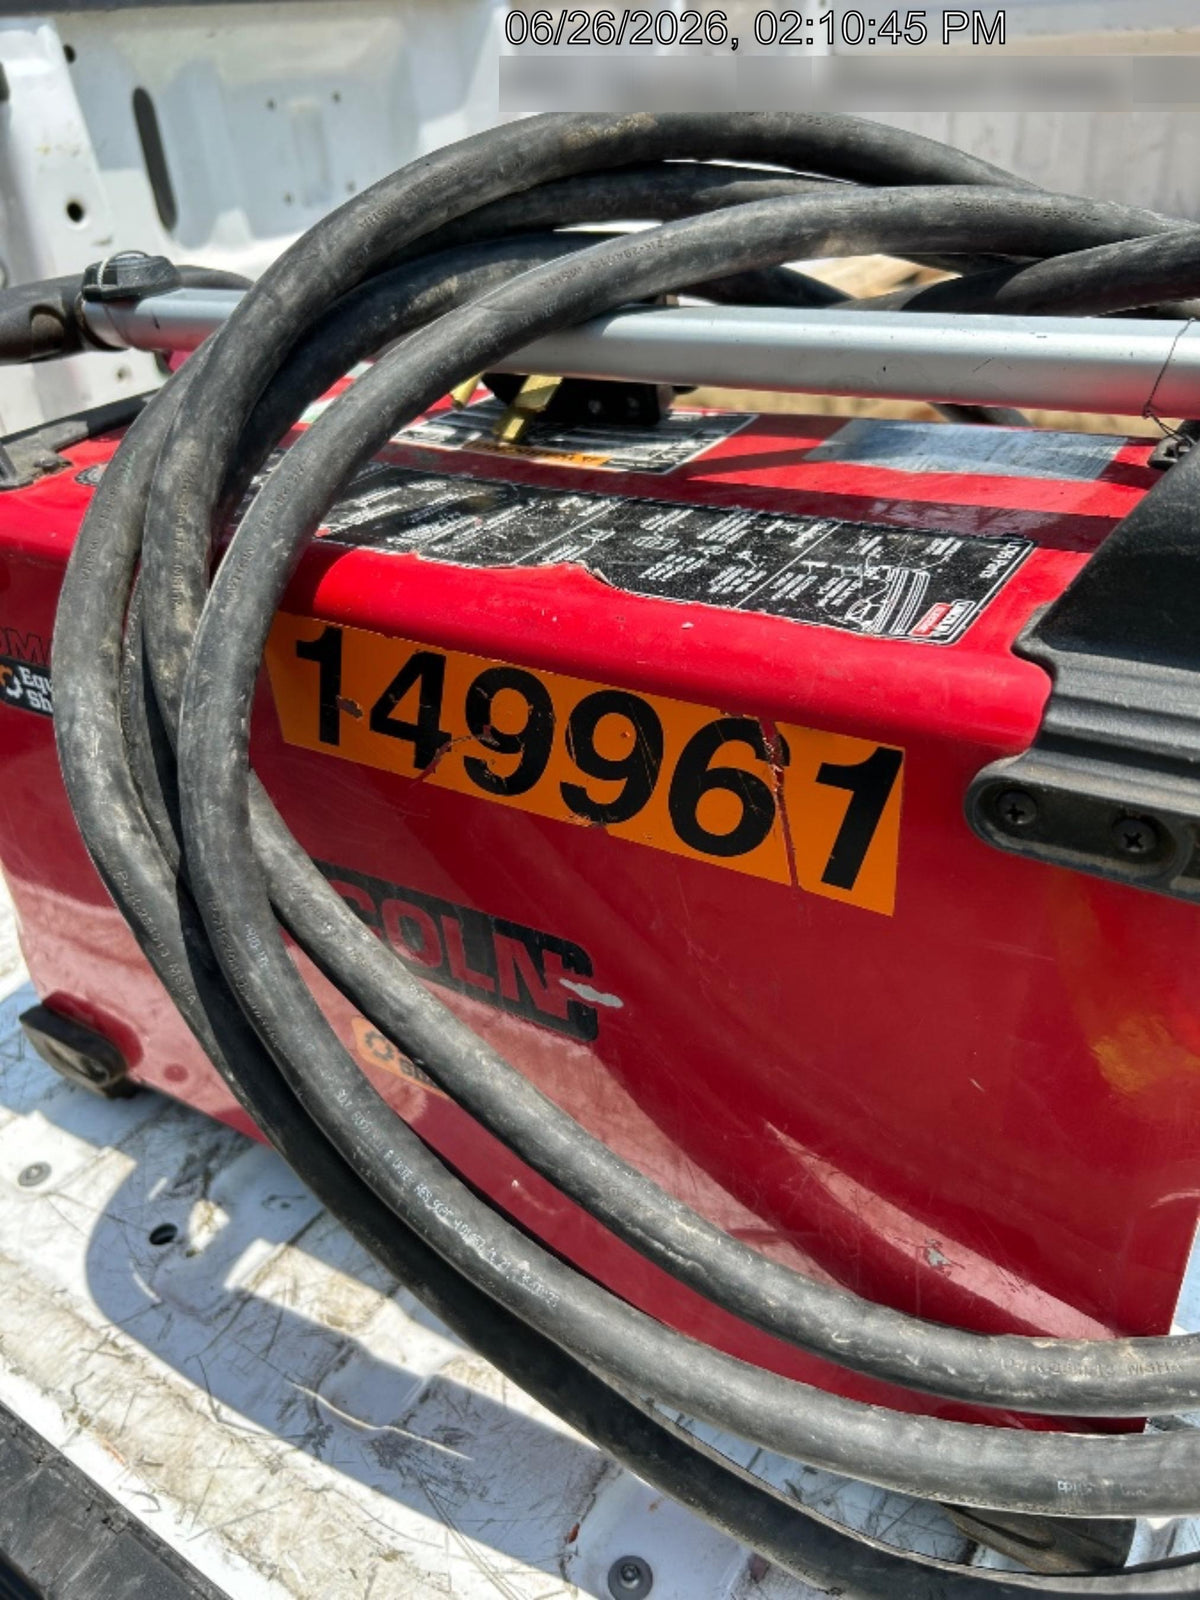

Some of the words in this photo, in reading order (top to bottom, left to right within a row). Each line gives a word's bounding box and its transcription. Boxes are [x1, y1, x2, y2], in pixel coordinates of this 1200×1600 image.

[17, 664, 54, 695] Equ
[26, 689, 54, 713] Sh
[295, 626, 906, 892] 149961
